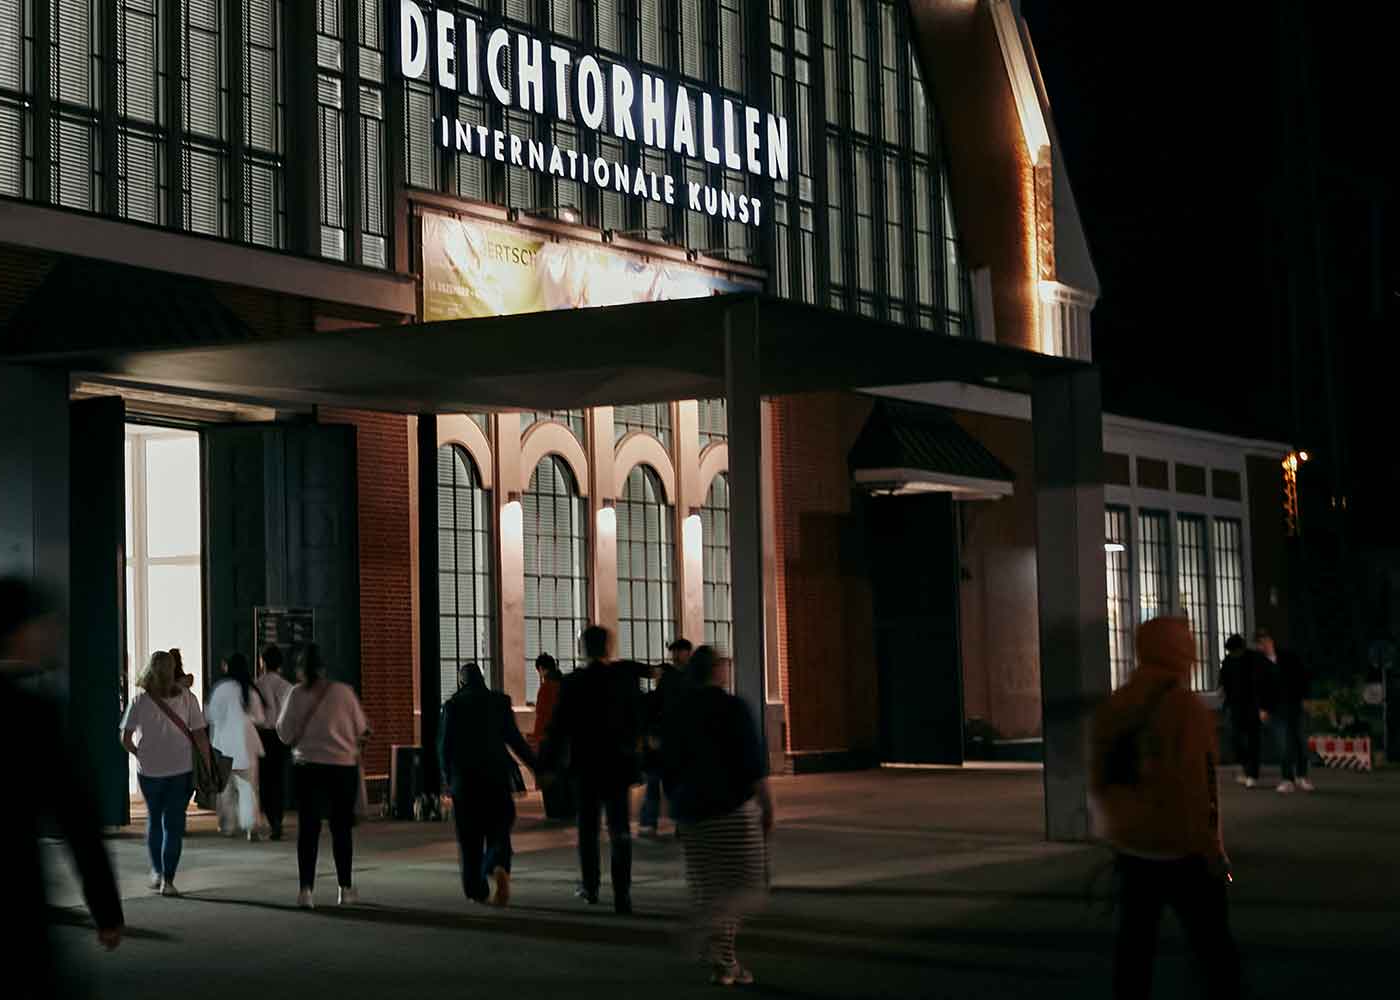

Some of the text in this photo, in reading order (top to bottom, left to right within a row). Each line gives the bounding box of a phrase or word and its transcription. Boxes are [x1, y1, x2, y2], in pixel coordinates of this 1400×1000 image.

[401, 0, 788, 181] DEICHTORHALLEN
[442, 115, 761, 226] INTERNATIONALE KUNST
